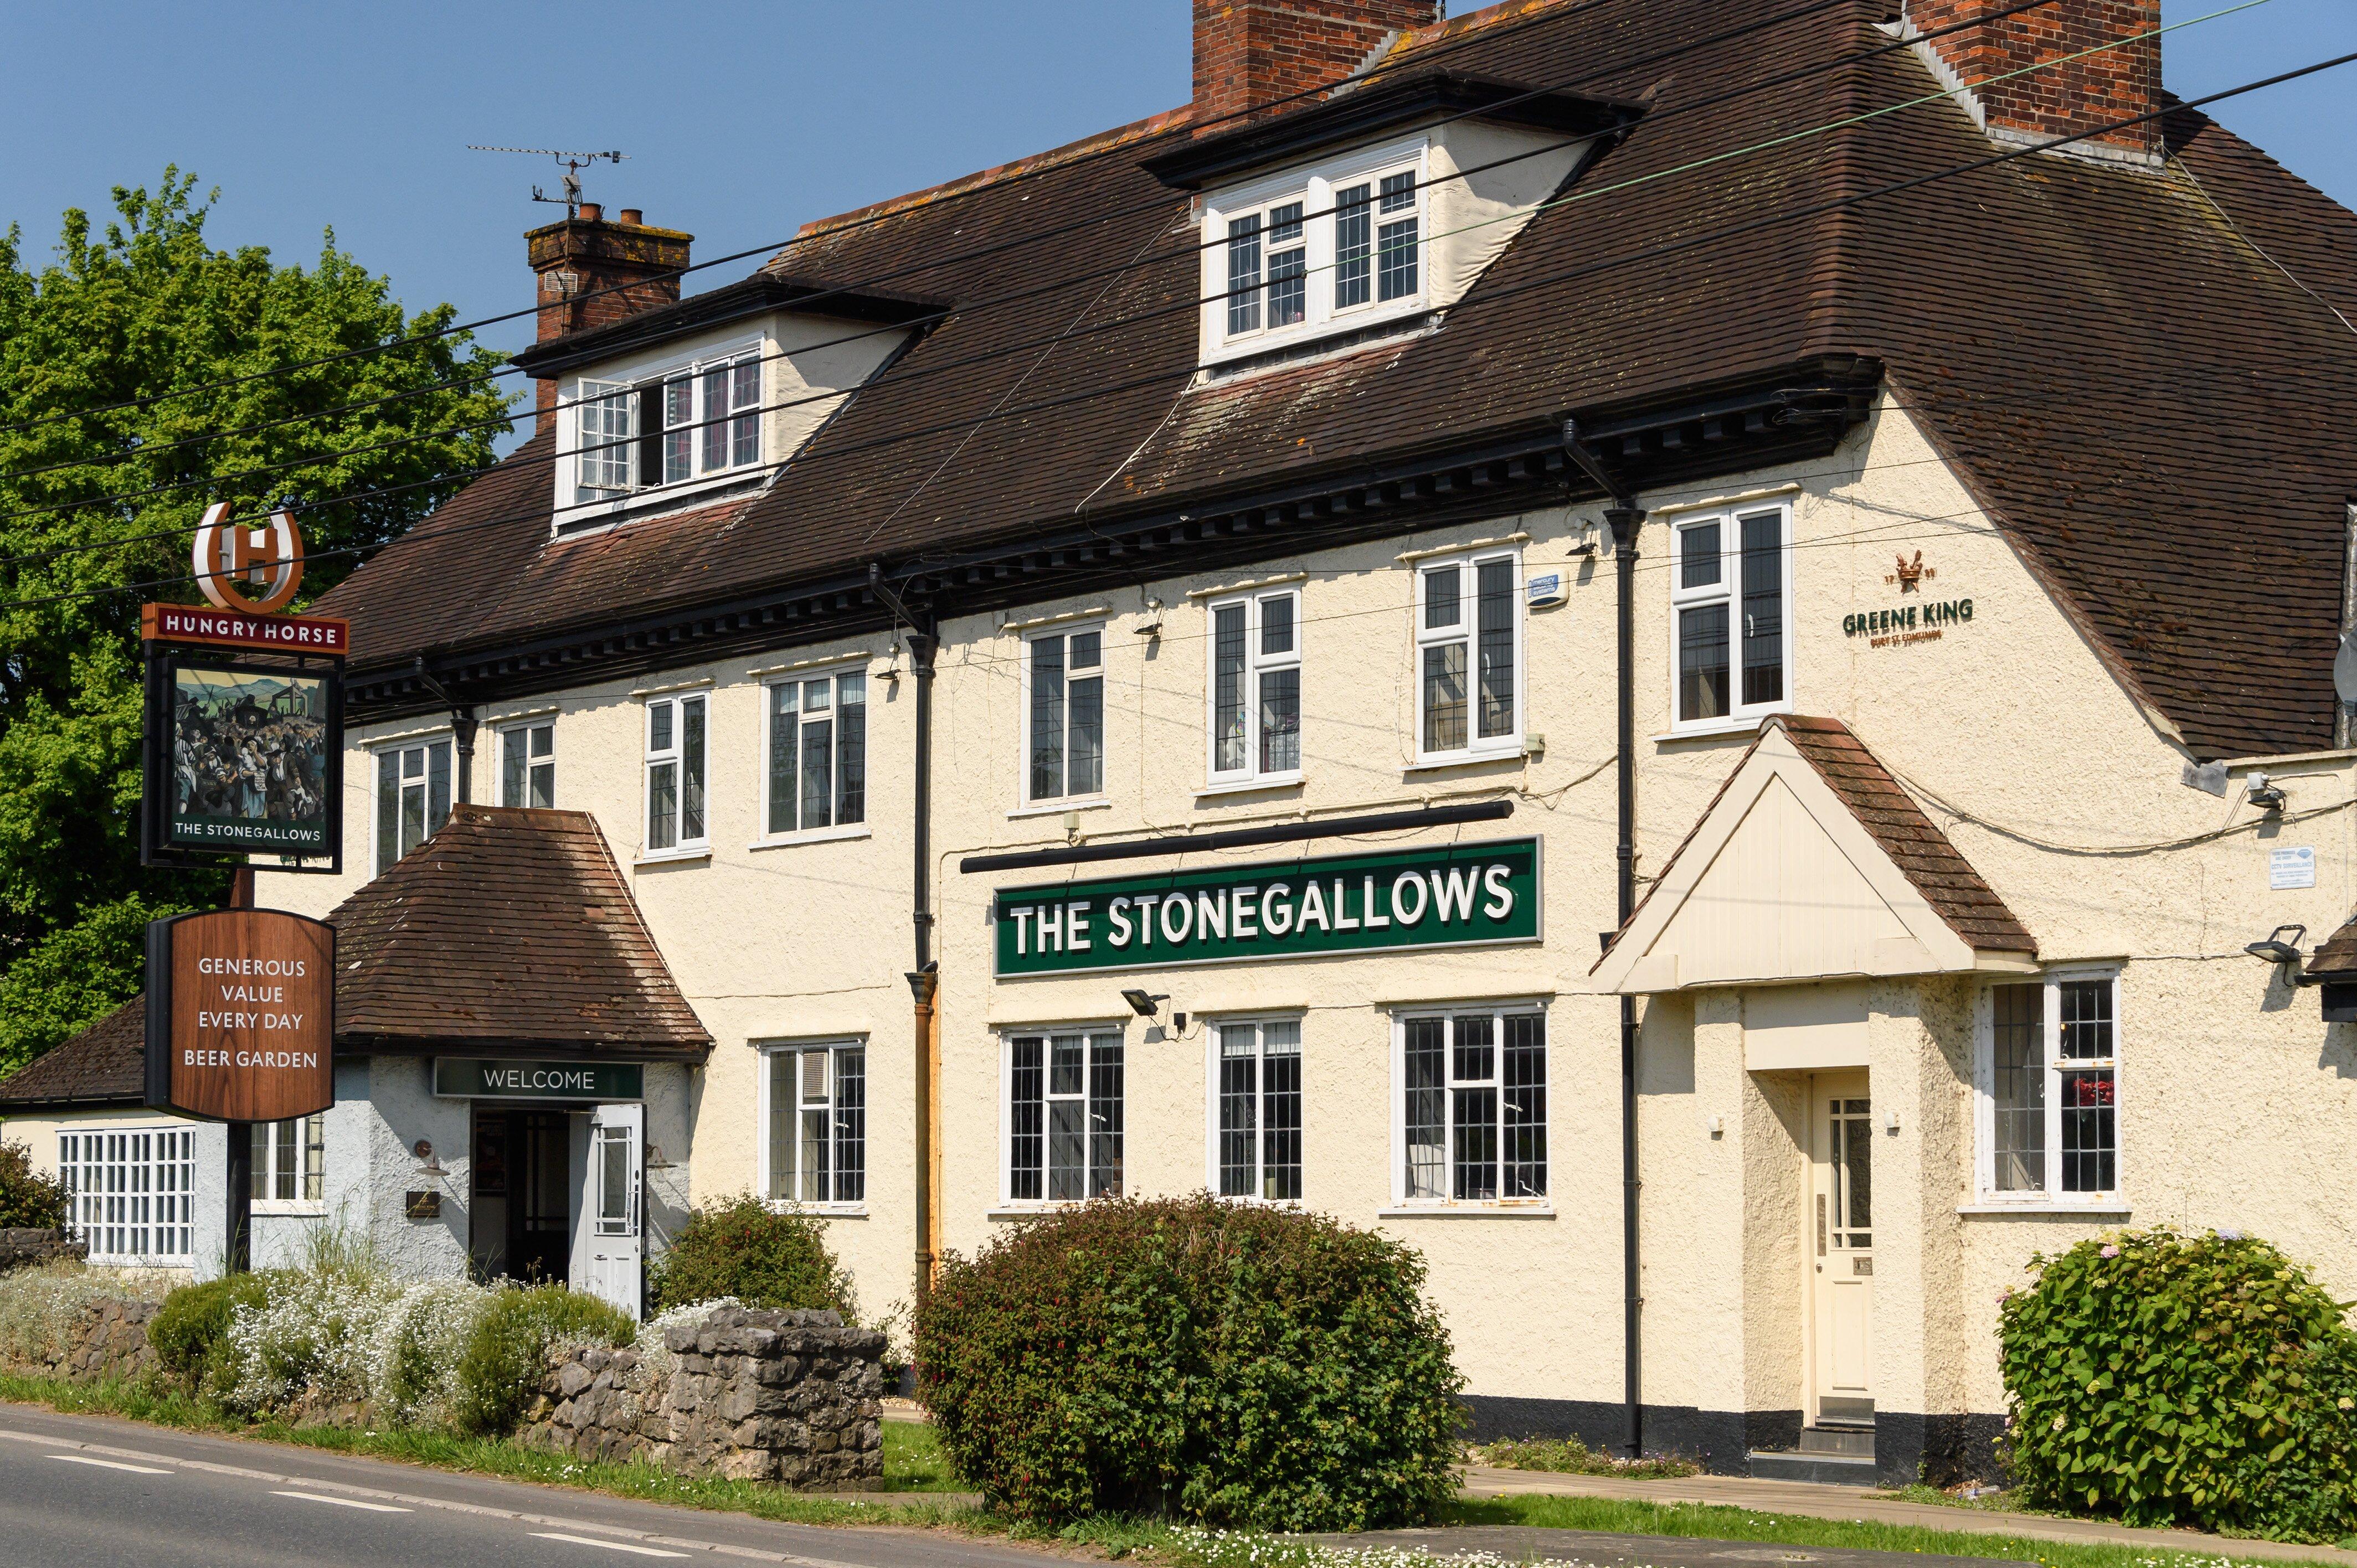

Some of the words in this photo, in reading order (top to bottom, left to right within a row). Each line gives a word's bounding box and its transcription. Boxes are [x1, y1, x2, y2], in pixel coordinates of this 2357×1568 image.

[1843, 606, 1916, 633] GREENE
[1923, 599, 1973, 623] KING
[167, 615, 257, 637] HUNGRY
[265, 624, 336, 643] HORSE
[1871, 636, 1890, 646] BURY
[1902, 630, 1942, 642] EDMUNDS
[175, 823, 202, 834] THE
[208, 824, 321, 841] STONEGALLOWS
[1010, 901, 1091, 954] THE
[1107, 864, 1514, 947] STONEGALLOWS
[198, 958, 305, 977] GENEROUS
[222, 985, 284, 1003] VALUE
[199, 1012, 259, 1029] EVERY
[264, 1013, 303, 1029] DAY
[184, 1050, 231, 1066] BEER
[236, 1051, 317, 1068] GARDEN
[484, 1070, 595, 1090] WELCOME
